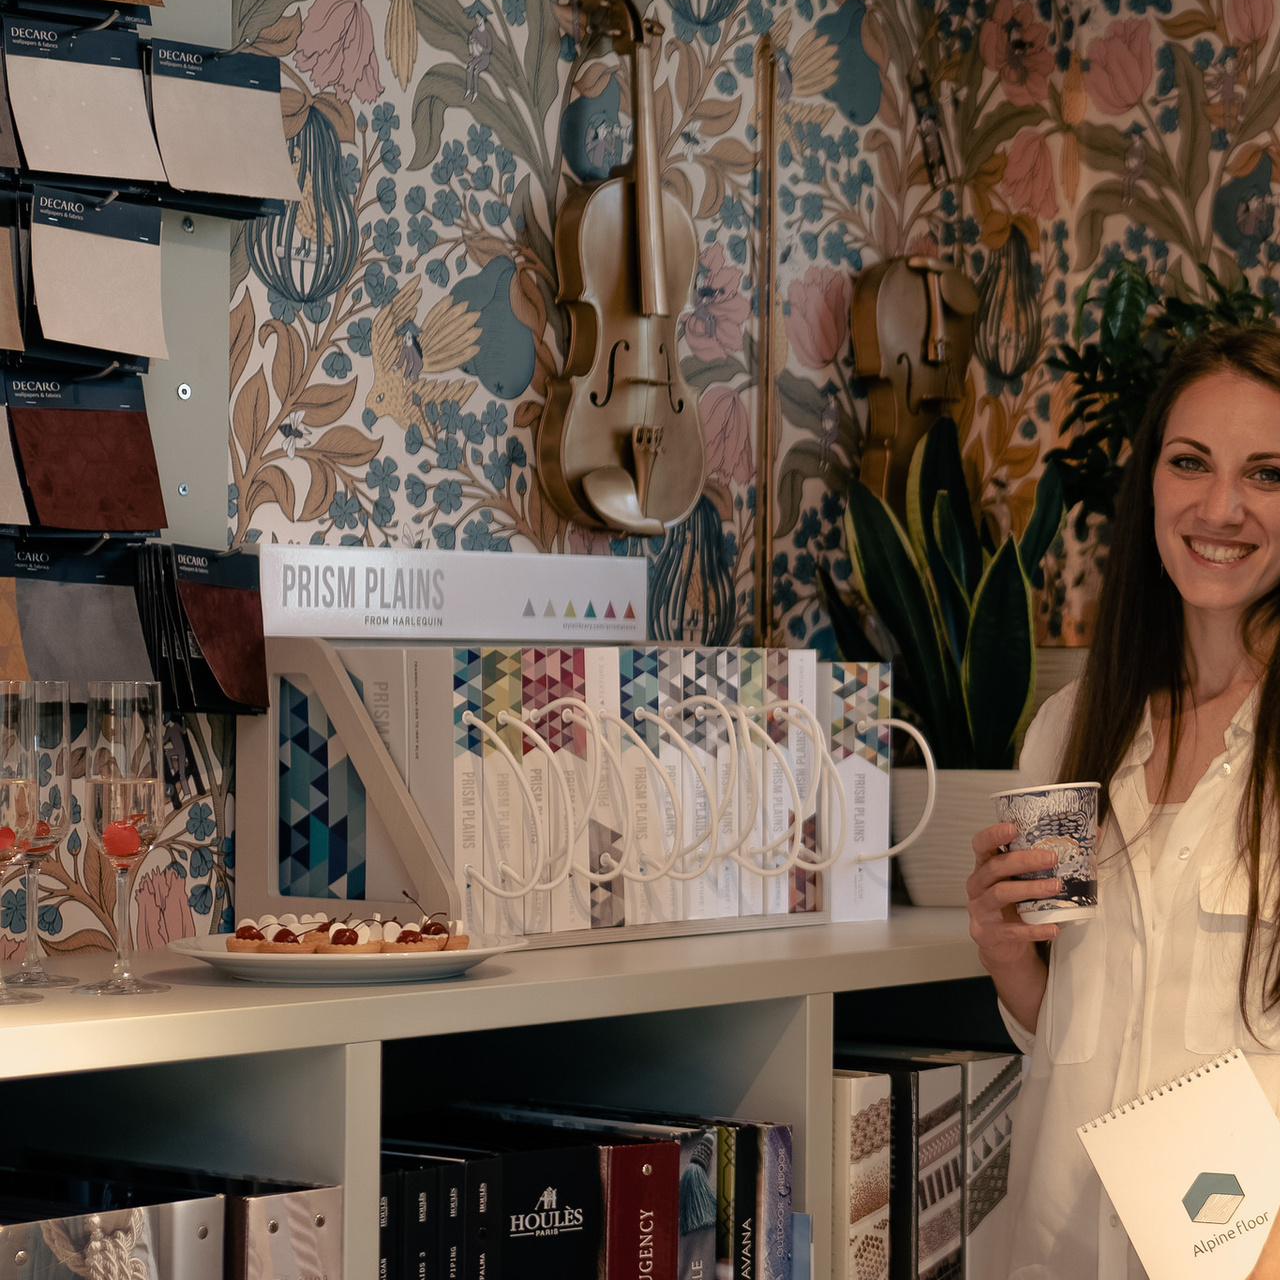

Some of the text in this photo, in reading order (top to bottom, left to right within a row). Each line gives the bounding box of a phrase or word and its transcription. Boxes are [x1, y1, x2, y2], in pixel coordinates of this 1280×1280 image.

[10, 26, 58, 42] DECARO
[12, 39, 37, 47] wallpapers
[158, 48, 203, 65] DECARO
[159, 60, 183, 69] wallpapers
[187, 63, 203, 72] fabrics
[39, 196, 85, 214] DECARO
[39, 208, 63, 218] wallpapers
[69, 212, 84, 221] fabrics
[12, 381, 60, 392] DECARO
[177, 554, 209, 568] DECARO
[282, 563, 445, 610] PRISM PLAINS
[364, 615, 443, 627] FROM HARLEQUIN
[635, 766, 648, 840] PRISM PLAINS
[773, 762, 784, 833] PRISM PLAINS
[462, 772, 476, 850] PRISM PLAINS
[497, 773, 511, 850] PRISM PLAINS
[853, 773, 866, 842] PRISM PLAINS
[510, 1205, 584, 1232] HOULÈS
[535, 1228, 559, 1237] PARIS
[1193, 1211, 1269, 1258] Alpine floor
